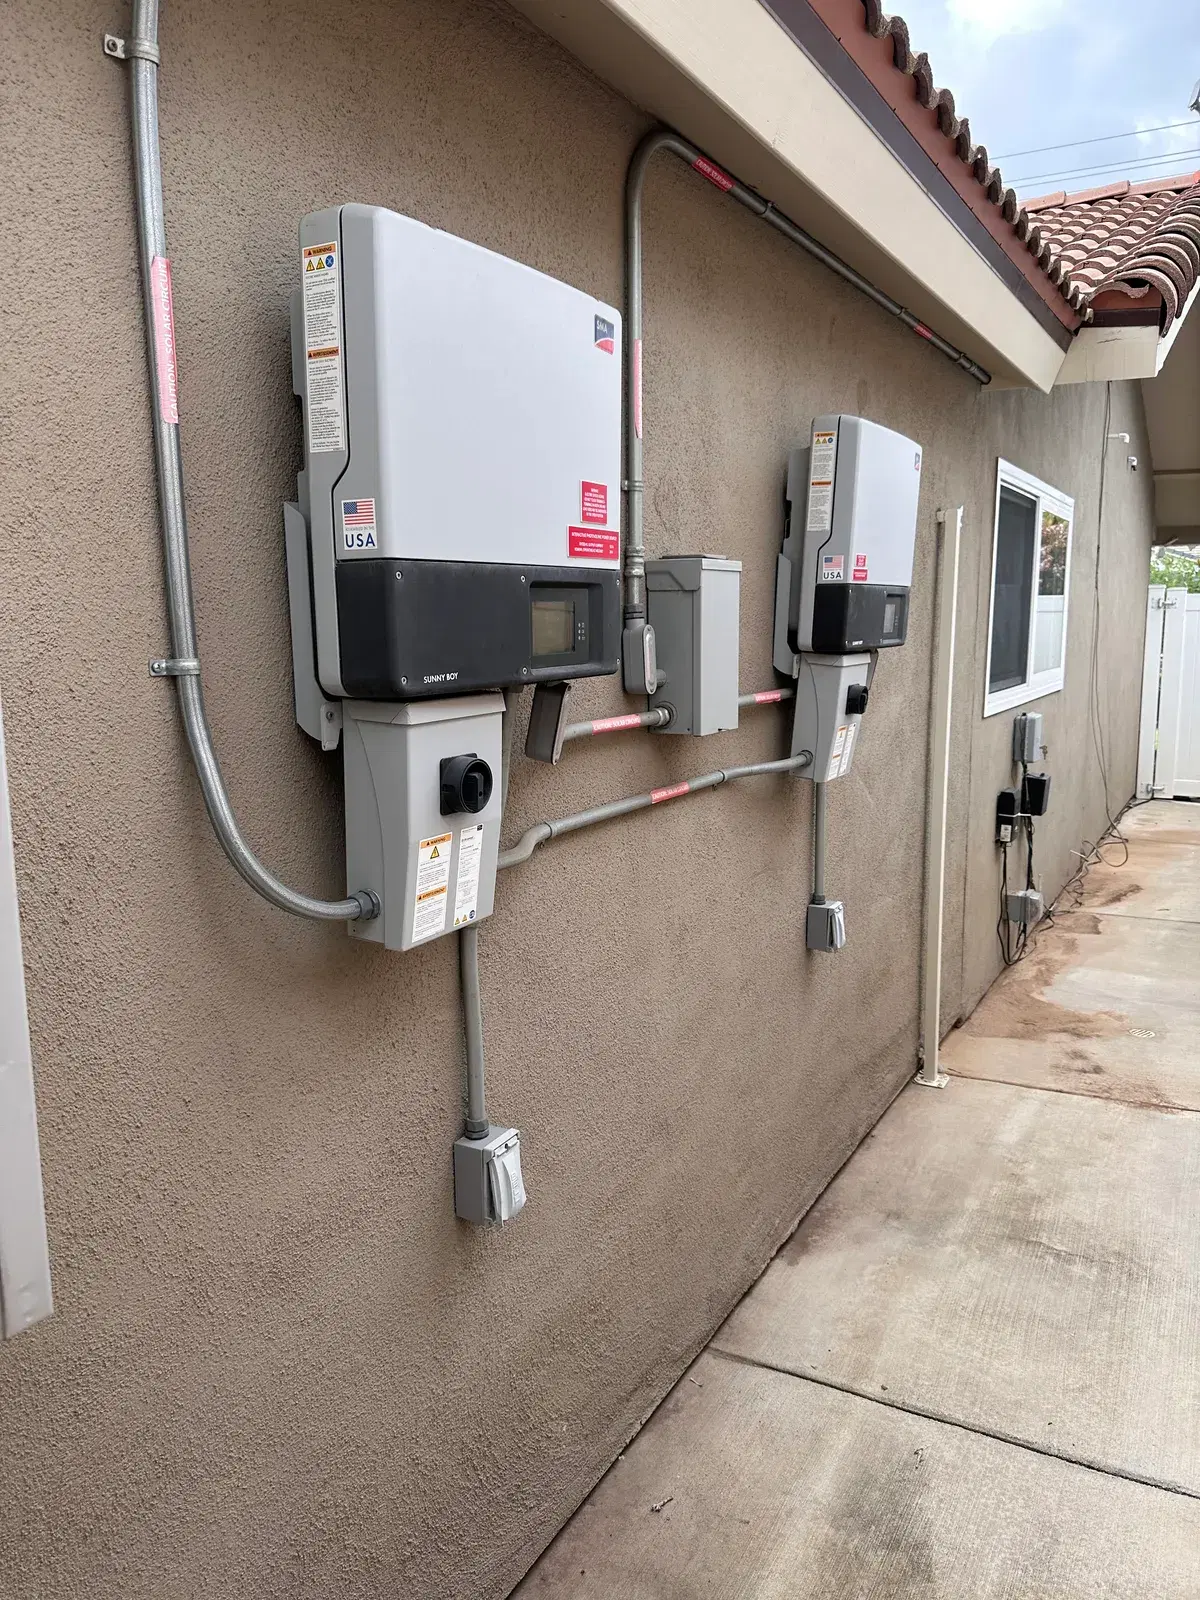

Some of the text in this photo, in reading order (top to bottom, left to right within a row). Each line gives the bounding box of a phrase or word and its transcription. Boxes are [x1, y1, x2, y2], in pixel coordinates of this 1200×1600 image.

[158, 260, 170, 311] CIRCUIT
[163, 313, 174, 356] SOLAR
[596, 320, 608, 334] SMA
[345, 532, 376, 548] USA
[823, 571, 842, 580] USA
[423, 672, 459, 684] SUNNY BOY
